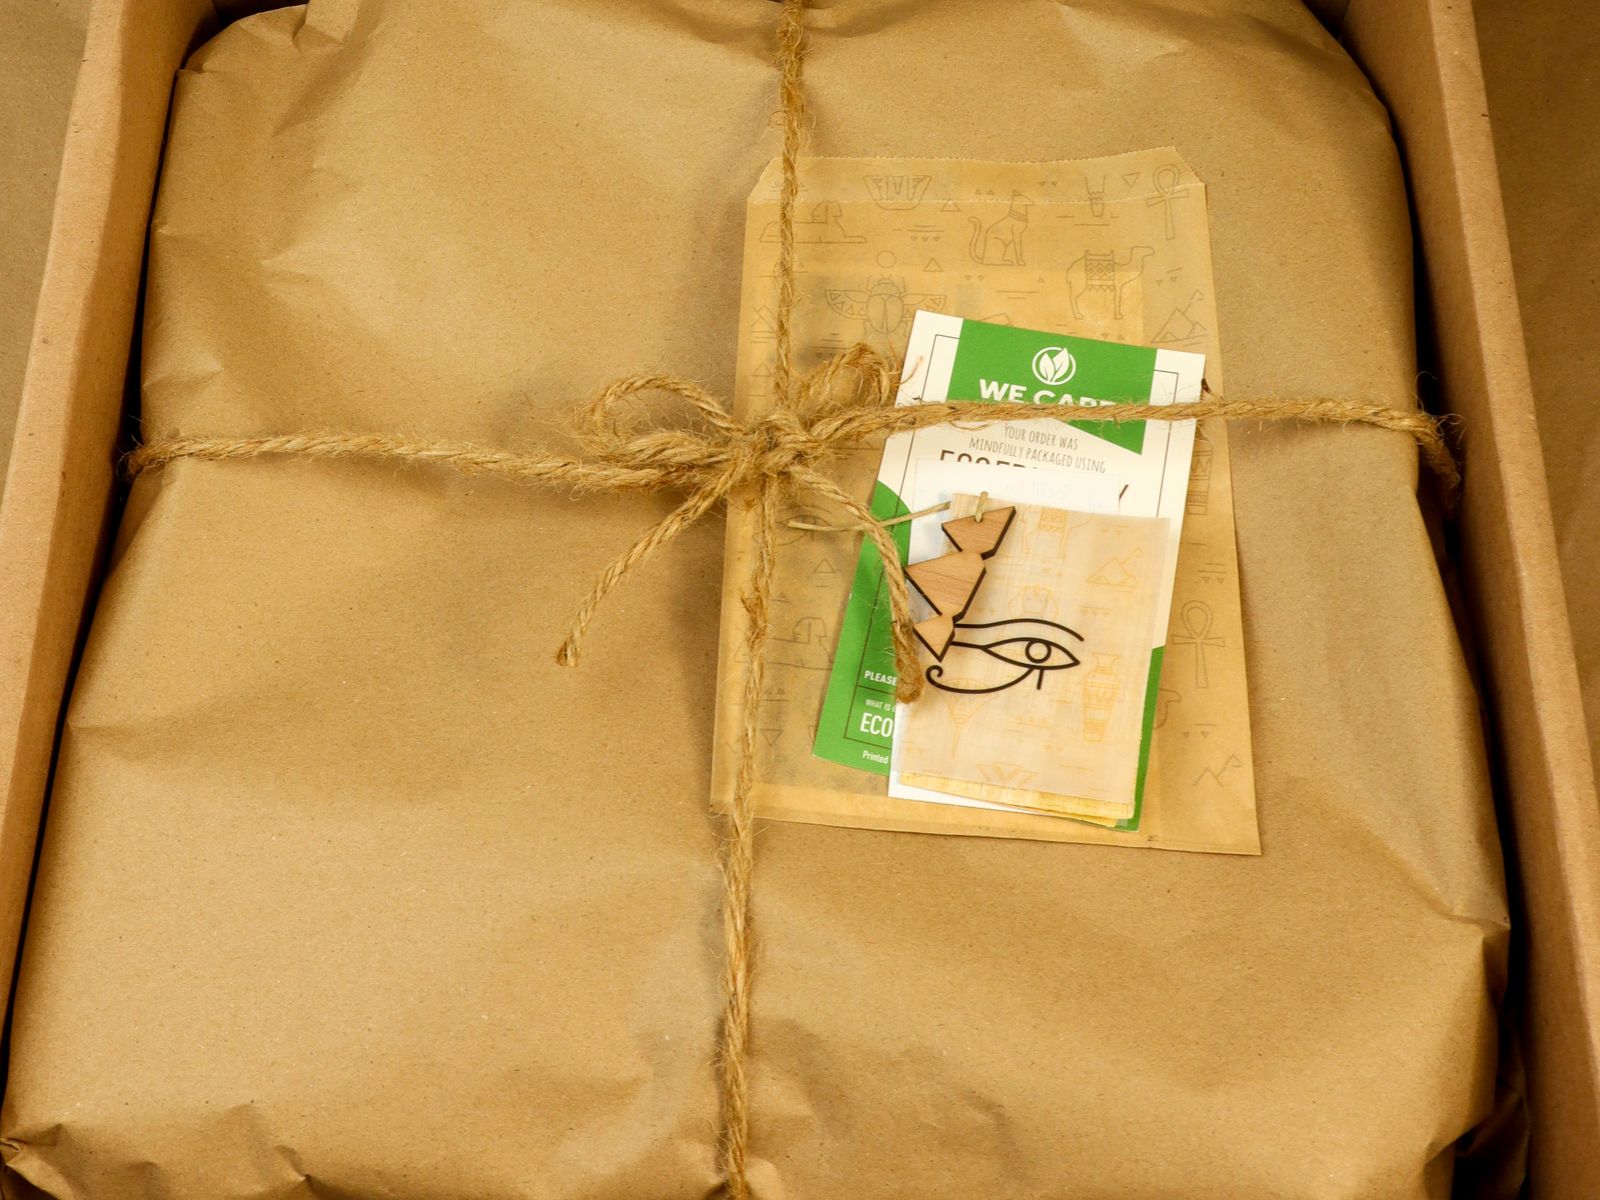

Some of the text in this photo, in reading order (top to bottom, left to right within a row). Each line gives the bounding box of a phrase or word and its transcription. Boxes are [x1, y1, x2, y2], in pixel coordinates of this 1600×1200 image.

[979, 378, 1027, 404] WE
[1004, 425, 1079, 451] YOUR ORDER WAS
[968, 437, 1025, 459] MINDFULLY
[1027, 447, 1072, 468] PACKAGED
[1075, 458, 1106, 474] USING
[864, 670, 897, 686] PLEASE
